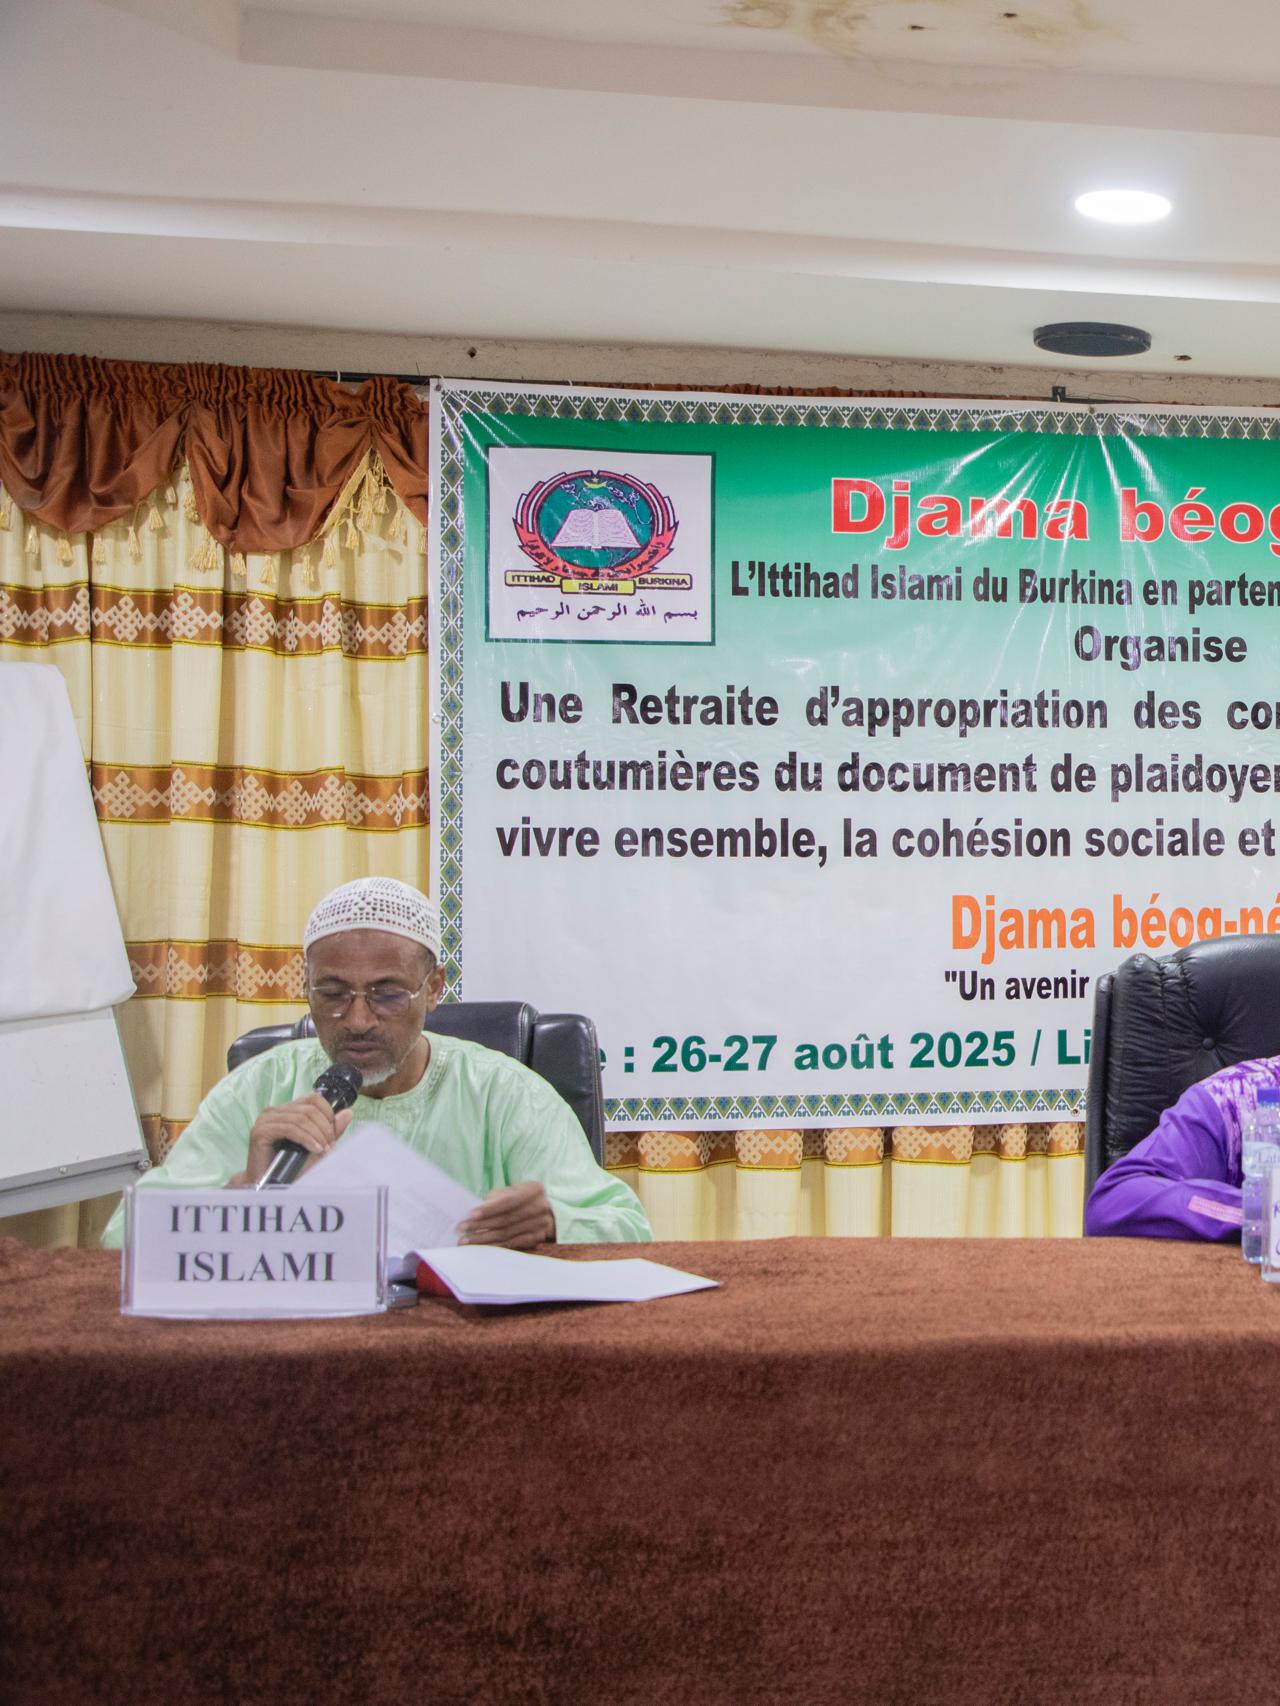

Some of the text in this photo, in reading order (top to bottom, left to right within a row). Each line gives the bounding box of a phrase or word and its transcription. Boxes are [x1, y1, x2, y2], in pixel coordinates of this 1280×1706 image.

[830, 477, 1089, 548] Djama
[511, 574, 555, 583] ITTIHAD
[578, 582, 618, 591] ISLAMI
[638, 577, 688, 586] BURKINA
[871, 566, 961, 601] Islami
[973, 566, 1008, 602] du
[1020, 568, 1133, 605] Burkina
[1143, 578, 1177, 606] en
[1074, 626, 1247, 670] Organise
[501, 681, 582, 724] Une
[612, 683, 778, 728] Retraite
[1134, 690, 1201, 729] des
[497, 750, 758, 792] coutumières
[775, 752, 822, 793] du
[838, 752, 1037, 794] document
[1050, 753, 1095, 794] de
[497, 816, 599, 857] vivre
[615, 816, 827, 867] ensemble,
[844, 818, 877, 857] la
[893, 818, 1070, 857] cohésion
[1085, 818, 1224, 857] sociale
[1239, 820, 1275, 857] et
[951, 894, 1094, 964] Djama
[945, 969, 1089, 1001] "Un avenir
[652, 1034, 777, 1073] 26-27
[794, 1033, 893, 1071] août
[909, 1030, 1014, 1069] 2025
[1057, 1028, 1092, 1067] Li
[170, 1204, 344, 1234] ITTIHAD
[176, 1251, 336, 1283] ISLAMI
